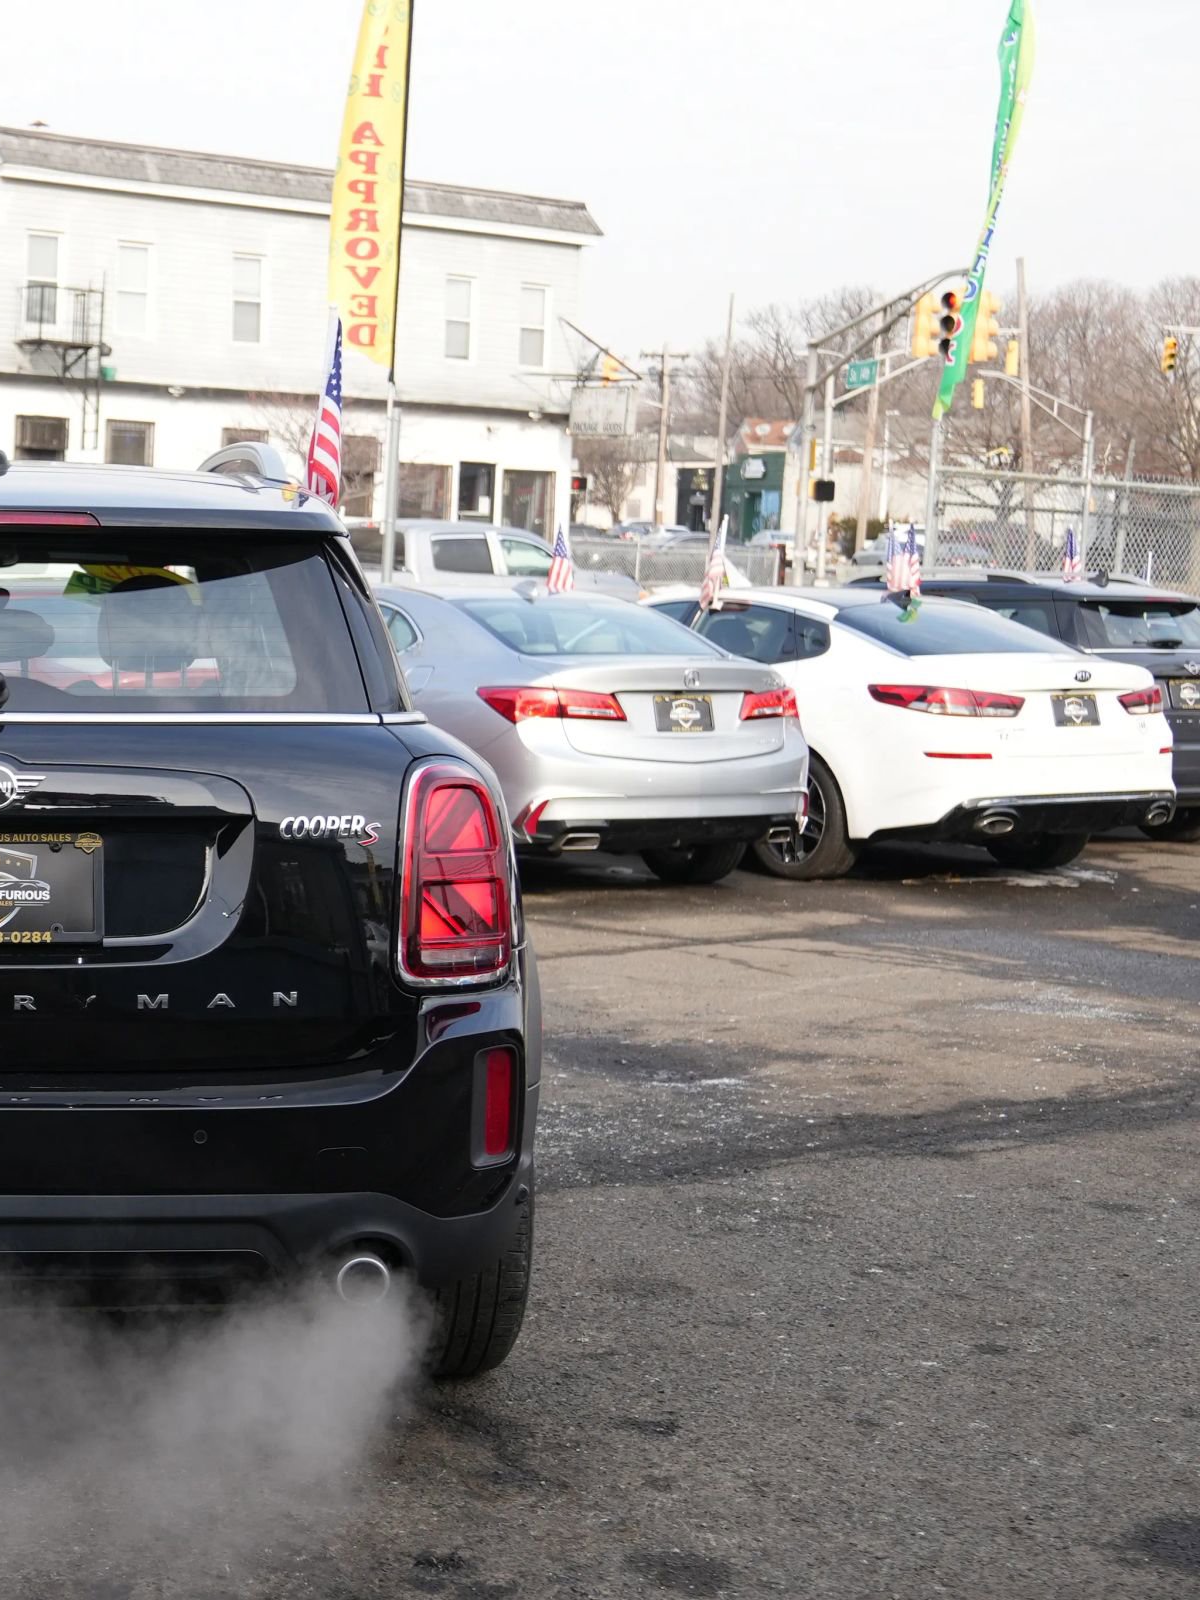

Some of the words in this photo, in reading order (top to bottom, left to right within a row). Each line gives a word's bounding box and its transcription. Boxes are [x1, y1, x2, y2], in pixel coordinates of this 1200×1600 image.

[603, 422, 622, 433] GOODS
[280, 815, 365, 839] COOPER
[357, 822, 382, 846] S
[13, 833, 40, 843] AUTO
[41, 833, 71, 843] SALES
[0, 889, 50, 901] FURIOUS
